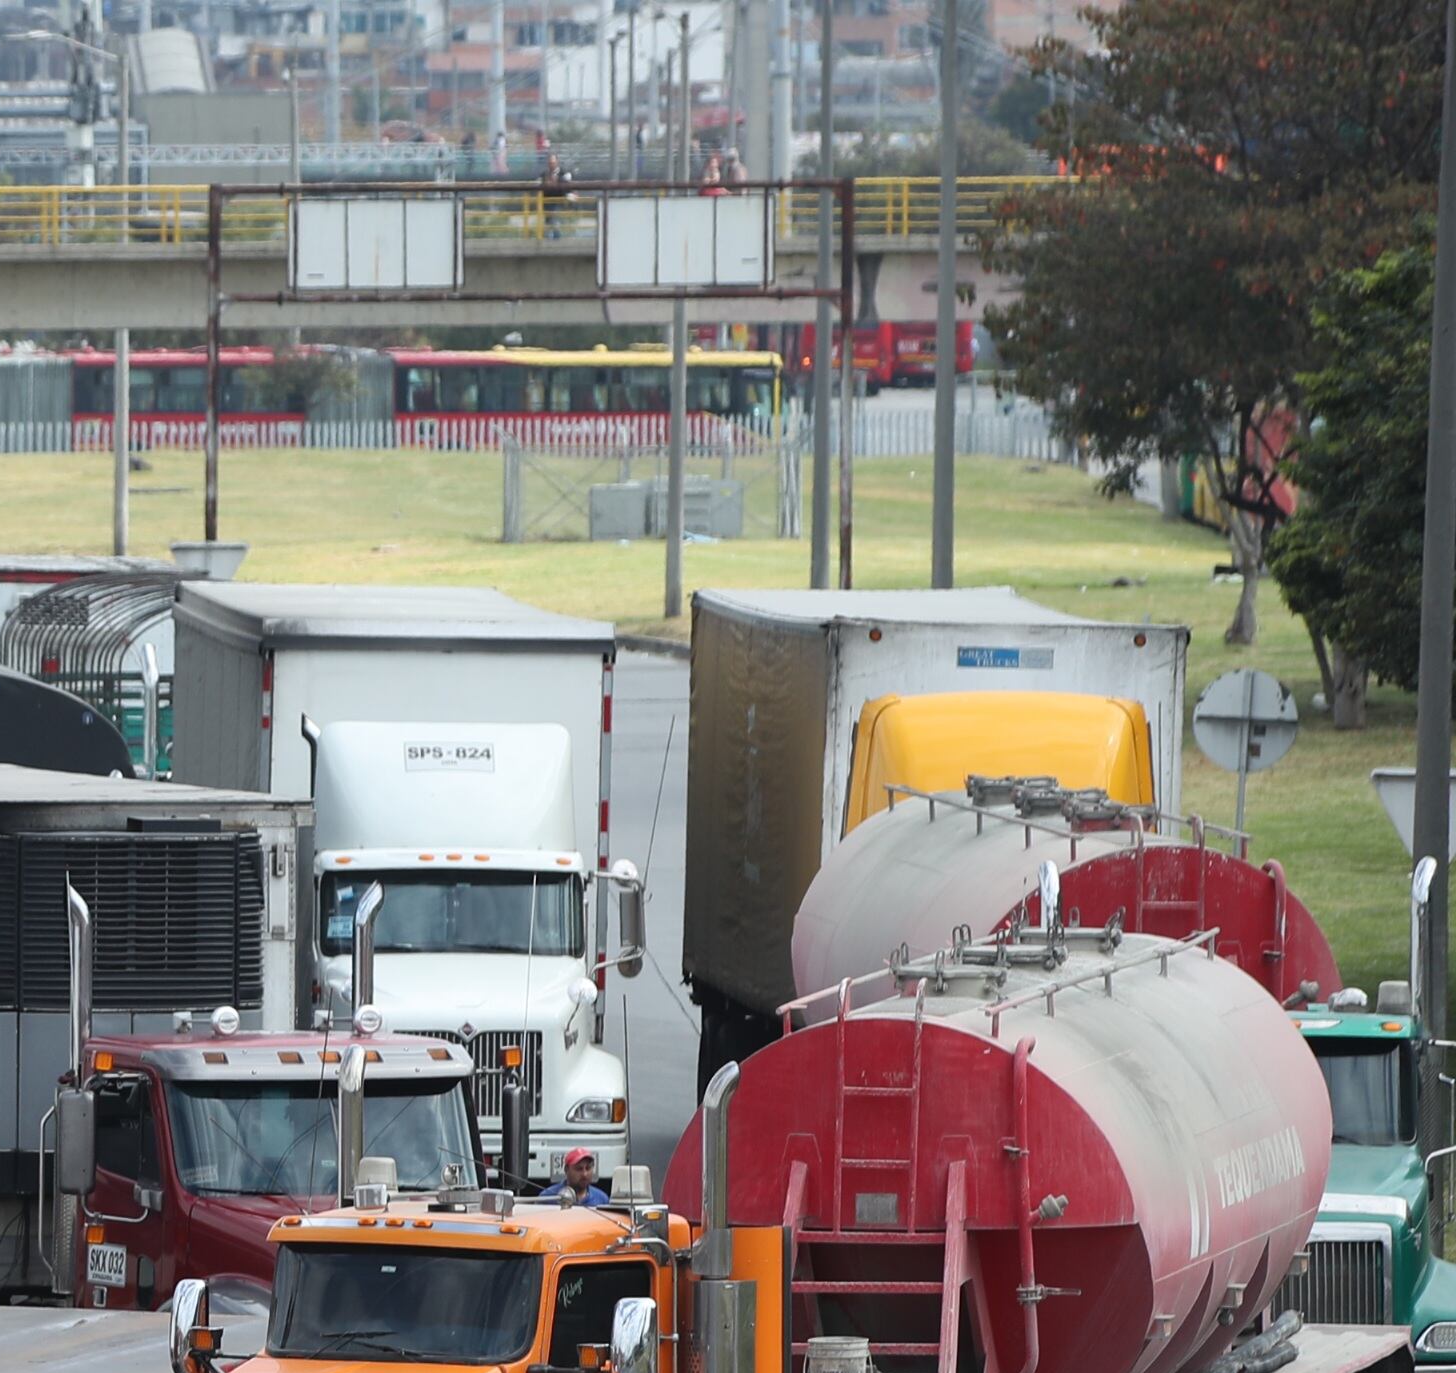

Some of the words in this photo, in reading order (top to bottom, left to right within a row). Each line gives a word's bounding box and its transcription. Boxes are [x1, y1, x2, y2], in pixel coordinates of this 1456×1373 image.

[1214, 1125, 1305, 1209] TEQUENDAMA
[90, 1248, 109, 1272] SKX
[109, 1250, 124, 1275] 032
